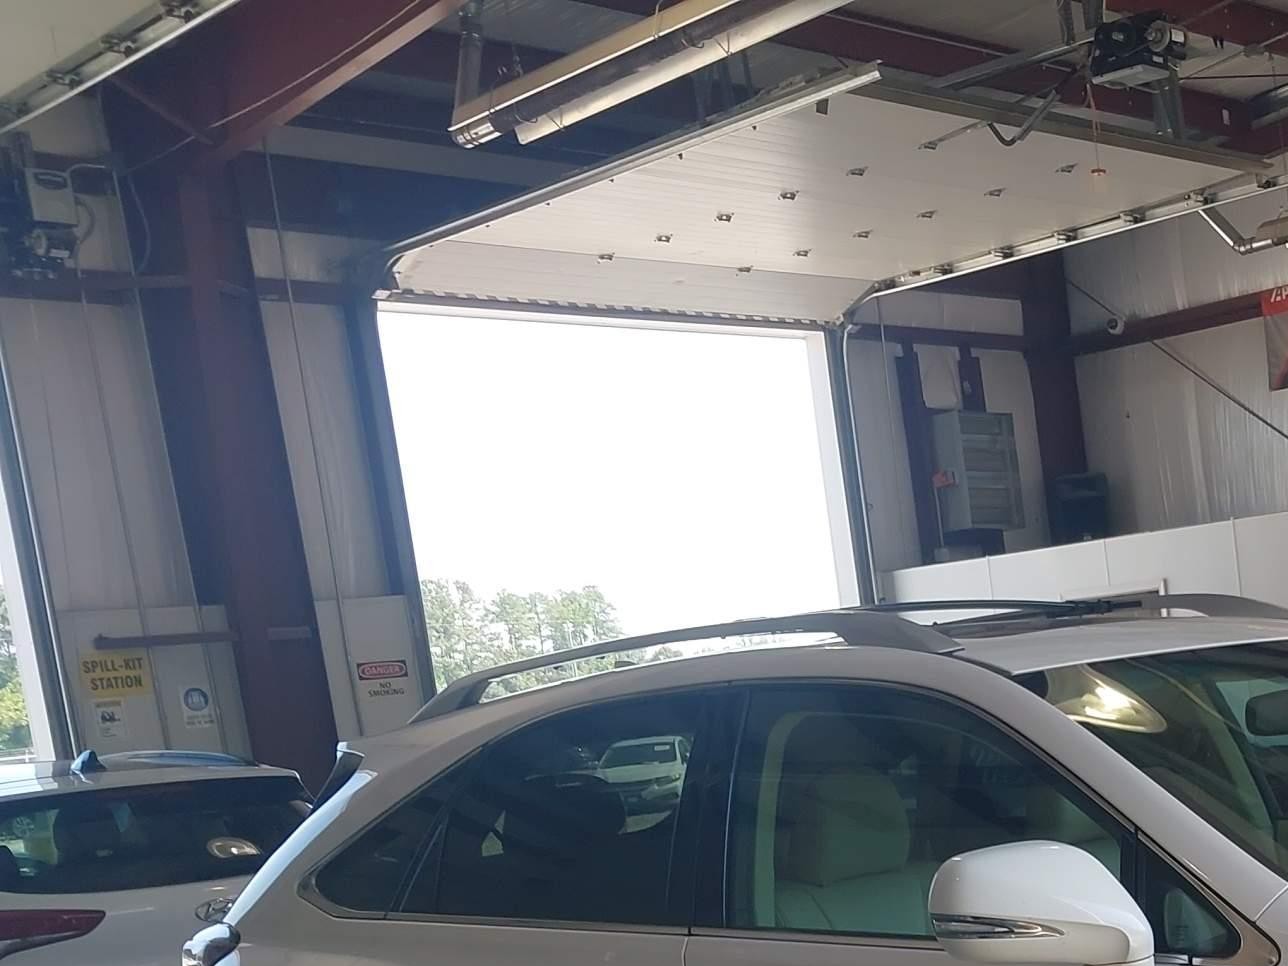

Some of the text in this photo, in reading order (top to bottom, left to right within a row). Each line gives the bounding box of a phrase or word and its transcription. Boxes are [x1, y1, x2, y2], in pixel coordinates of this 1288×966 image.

[82, 657, 144, 674] SPILL-KIT
[90, 675, 143, 691] STATION
[379, 681, 392, 689] NO
[367, 687, 405, 697] SMOKING
